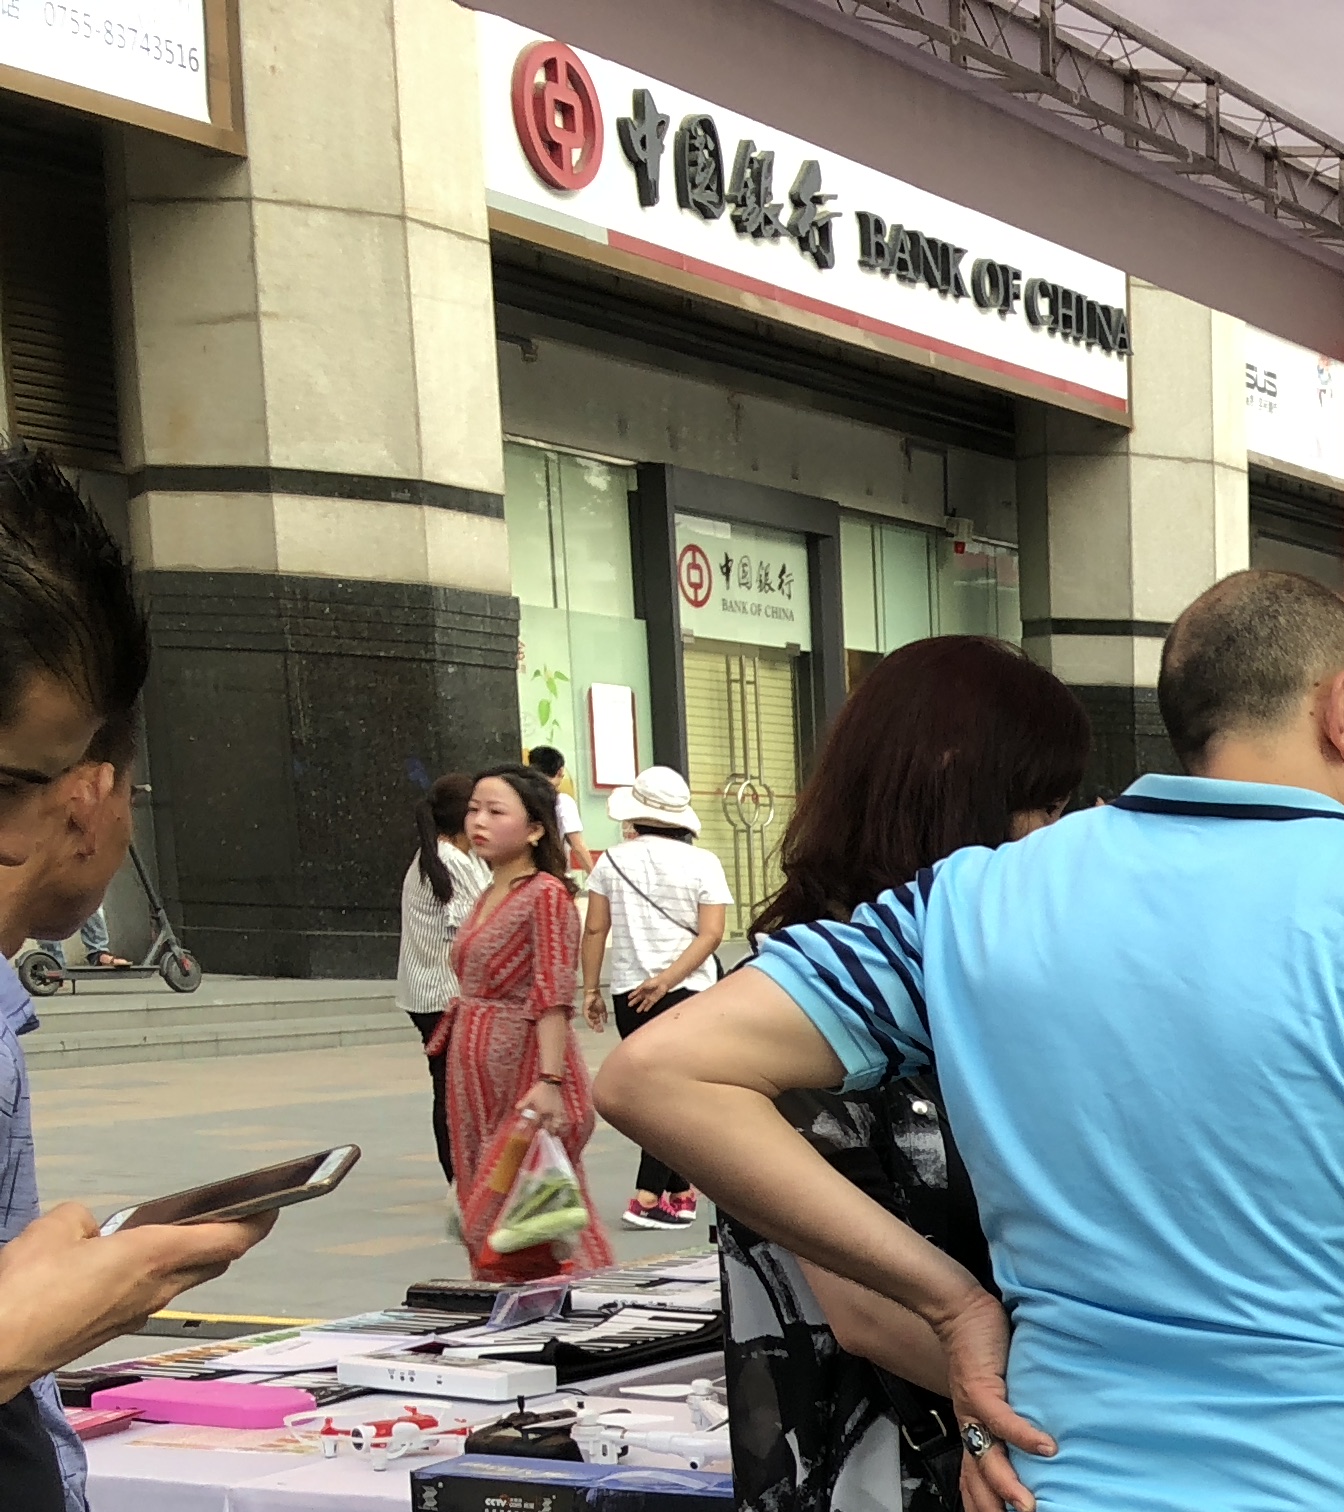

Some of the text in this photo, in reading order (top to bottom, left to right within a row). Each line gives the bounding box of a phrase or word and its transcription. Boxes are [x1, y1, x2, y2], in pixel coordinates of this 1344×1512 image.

[856, 210, 971, 299] BANK
[971, 257, 1022, 318] OF
[1024, 277, 1134, 356] CHINA
[719, 551, 795, 601] 中国银行
[722, 598, 795, 621] BANK OF CHINA
